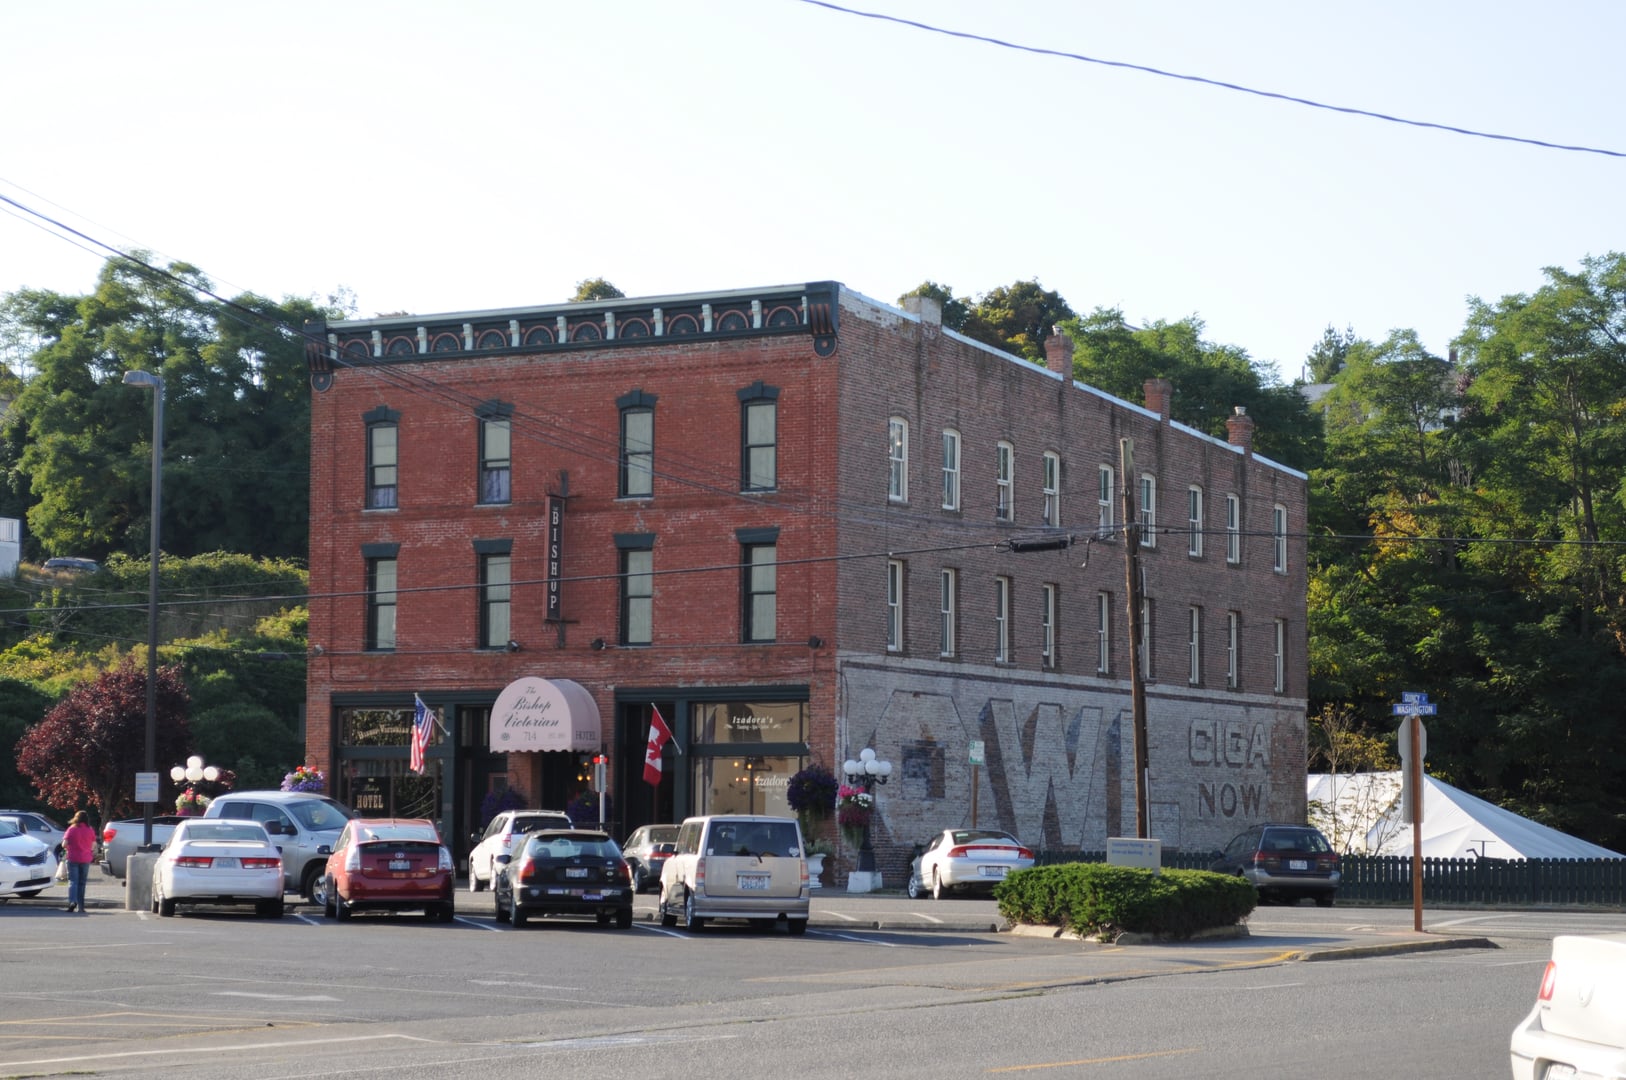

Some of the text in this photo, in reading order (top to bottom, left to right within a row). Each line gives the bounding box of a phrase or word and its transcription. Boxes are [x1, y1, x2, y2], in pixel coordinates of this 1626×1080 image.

[526, 686, 537, 694] The
[512, 696, 551, 713] Bishop
[1396, 705, 1433, 714] WASHINGTON
[504, 712, 559, 727] Victorian
[524, 731, 536, 741] 714
[575, 731, 596, 741] HOTEL
[357, 795, 383, 808] HOTEL
[1197, 782, 1263, 819] NOW
